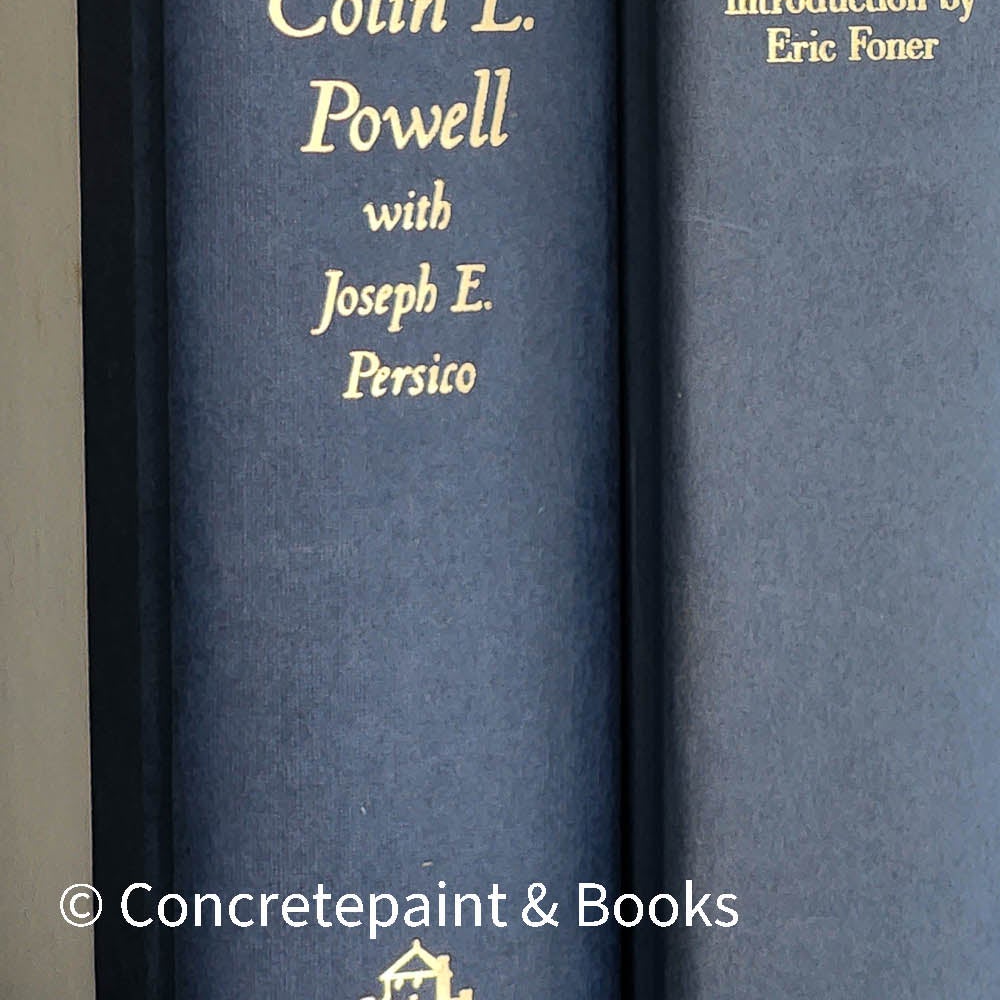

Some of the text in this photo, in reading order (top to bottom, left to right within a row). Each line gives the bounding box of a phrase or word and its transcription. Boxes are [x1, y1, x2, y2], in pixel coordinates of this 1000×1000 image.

[766, 25, 940, 63] Eric Foner
[301, 68, 511, 152] Powell
[363, 179, 452, 231] with
[310, 262, 493, 335] Joseph E.
[342, 351, 477, 399] Persico
